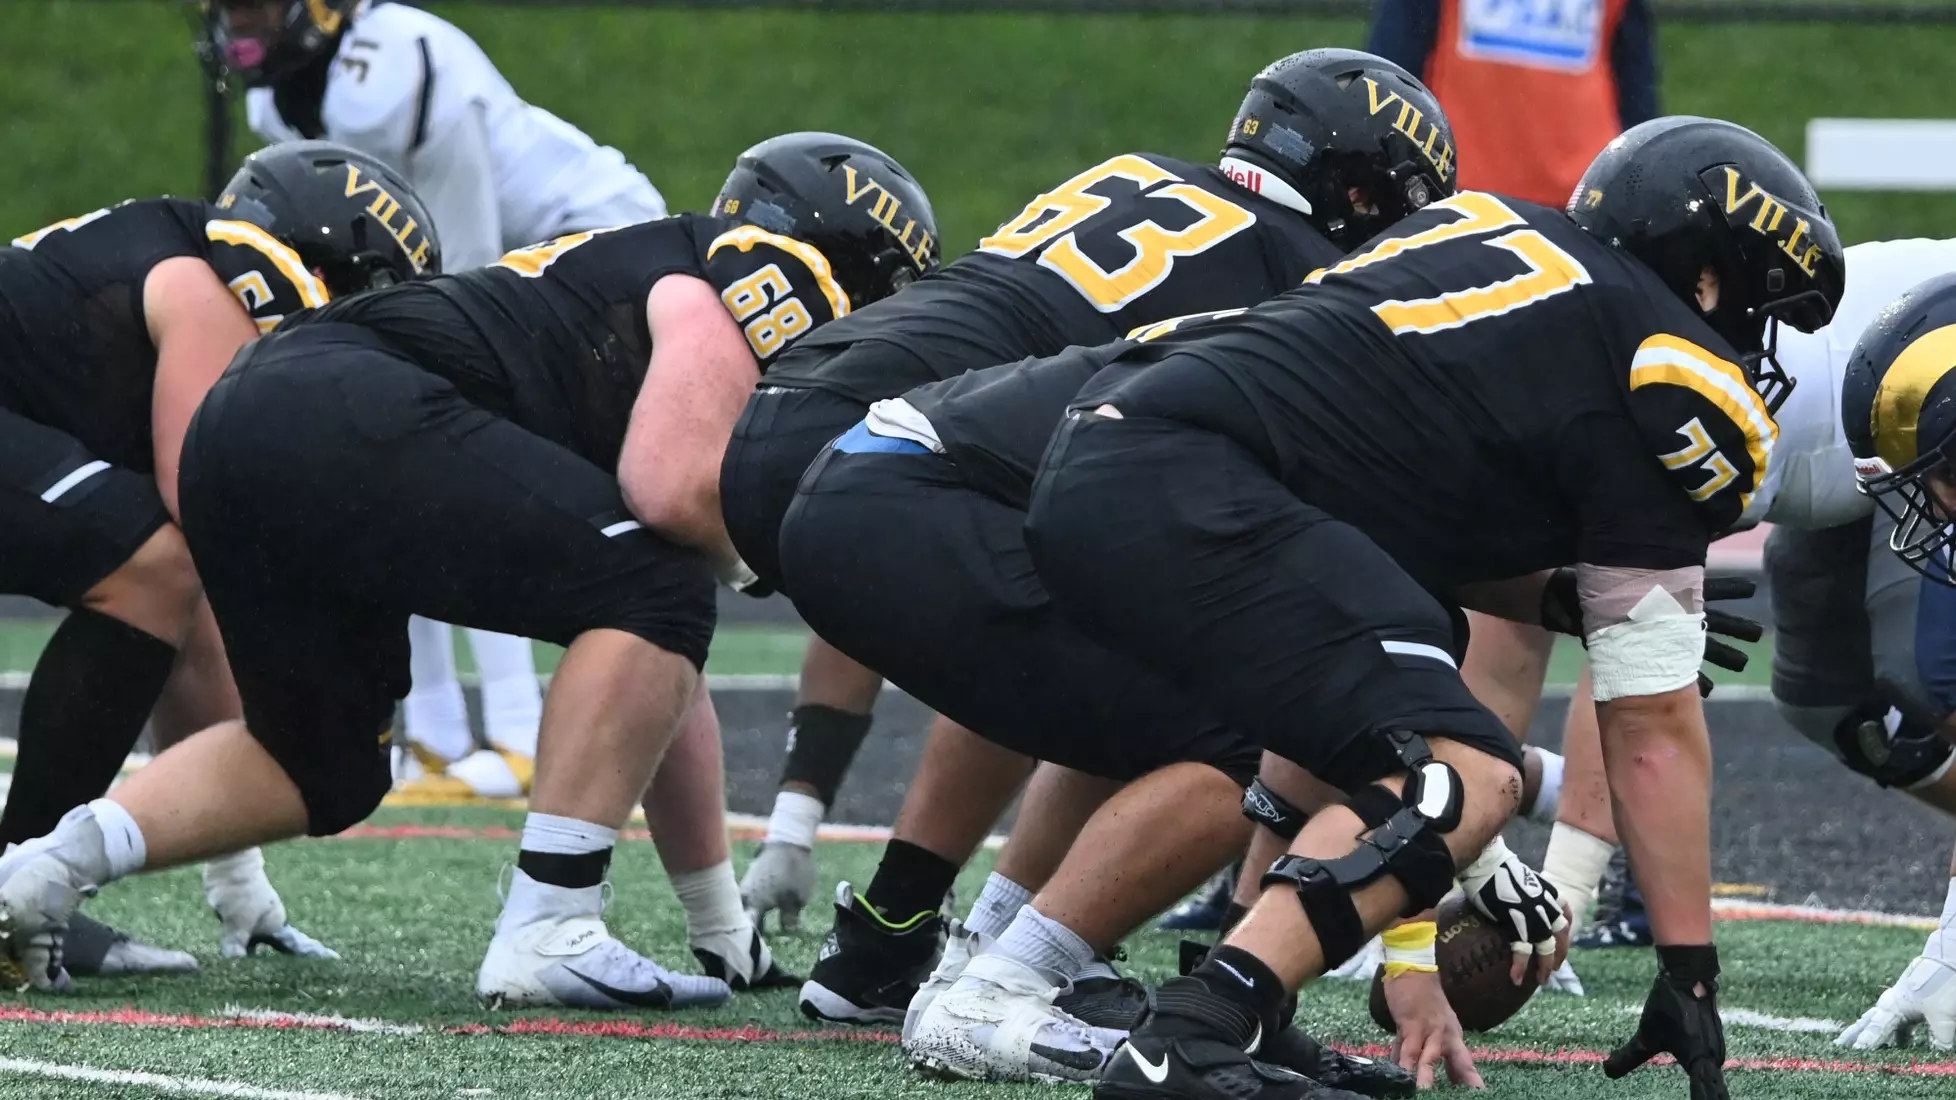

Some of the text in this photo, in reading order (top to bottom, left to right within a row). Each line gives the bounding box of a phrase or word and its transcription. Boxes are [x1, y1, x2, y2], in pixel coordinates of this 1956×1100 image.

[341, 38, 381, 84] 31
[1243, 119, 1260, 136] 63
[1363, 77, 1454, 183] VILLE
[345, 163, 430, 275] VILLE
[724, 199, 740, 215] 68
[842, 164, 934, 272] VILLE
[975, 154, 1257, 313] 63
[1724, 166, 1823, 278] VILLE
[721, 263, 814, 359] 68
[1302, 190, 1594, 336] 77
[1655, 416, 1740, 502] 77
